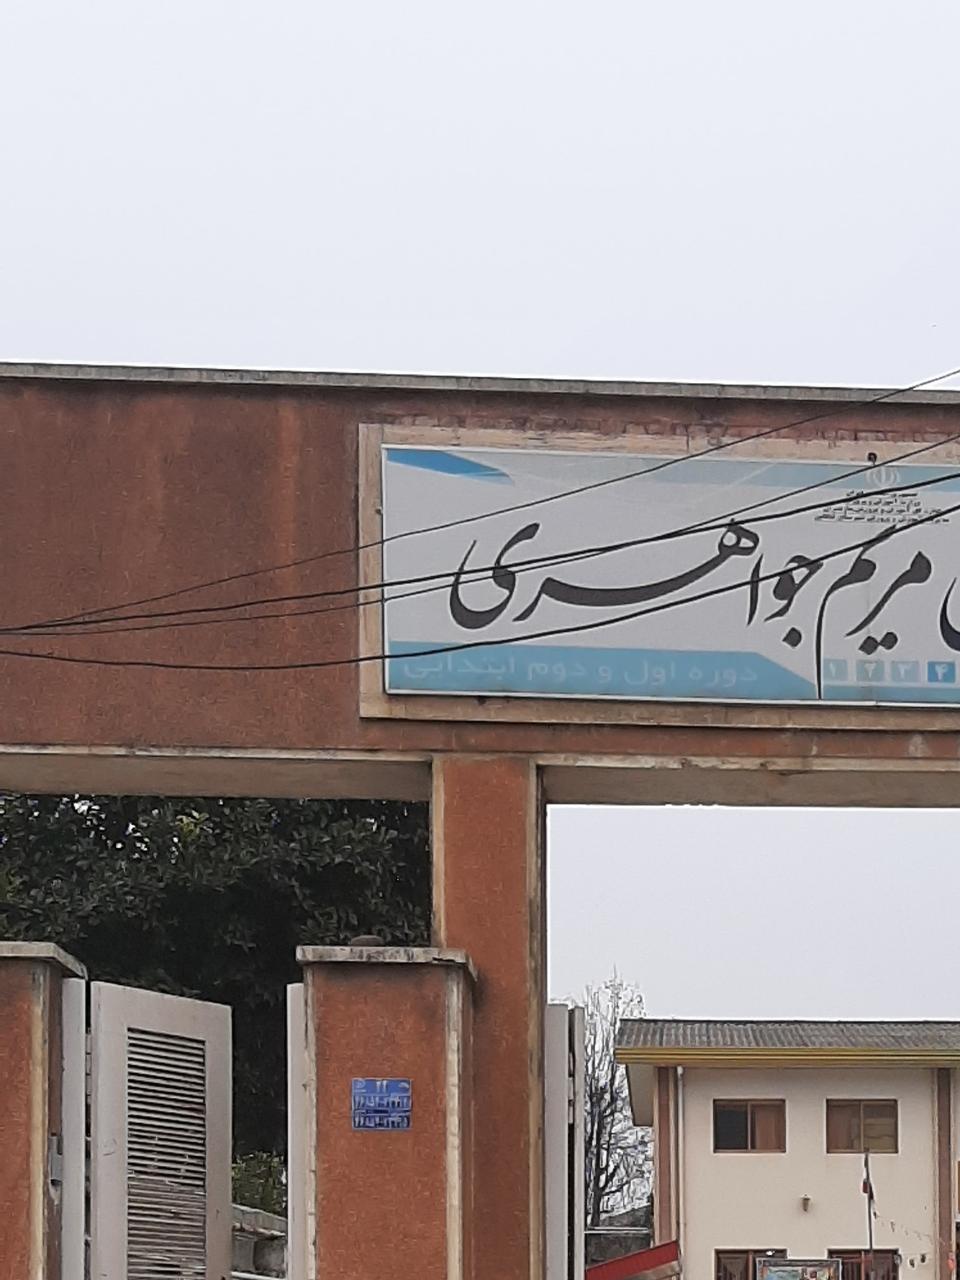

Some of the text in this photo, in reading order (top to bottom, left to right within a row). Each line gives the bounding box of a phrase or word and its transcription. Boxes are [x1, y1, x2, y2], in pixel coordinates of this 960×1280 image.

[449, 518, 824, 648] جواهری
[816, 524, 932, 698] مریم
[403, 655, 758, 686] دوره اول و دوم ابتدایی
